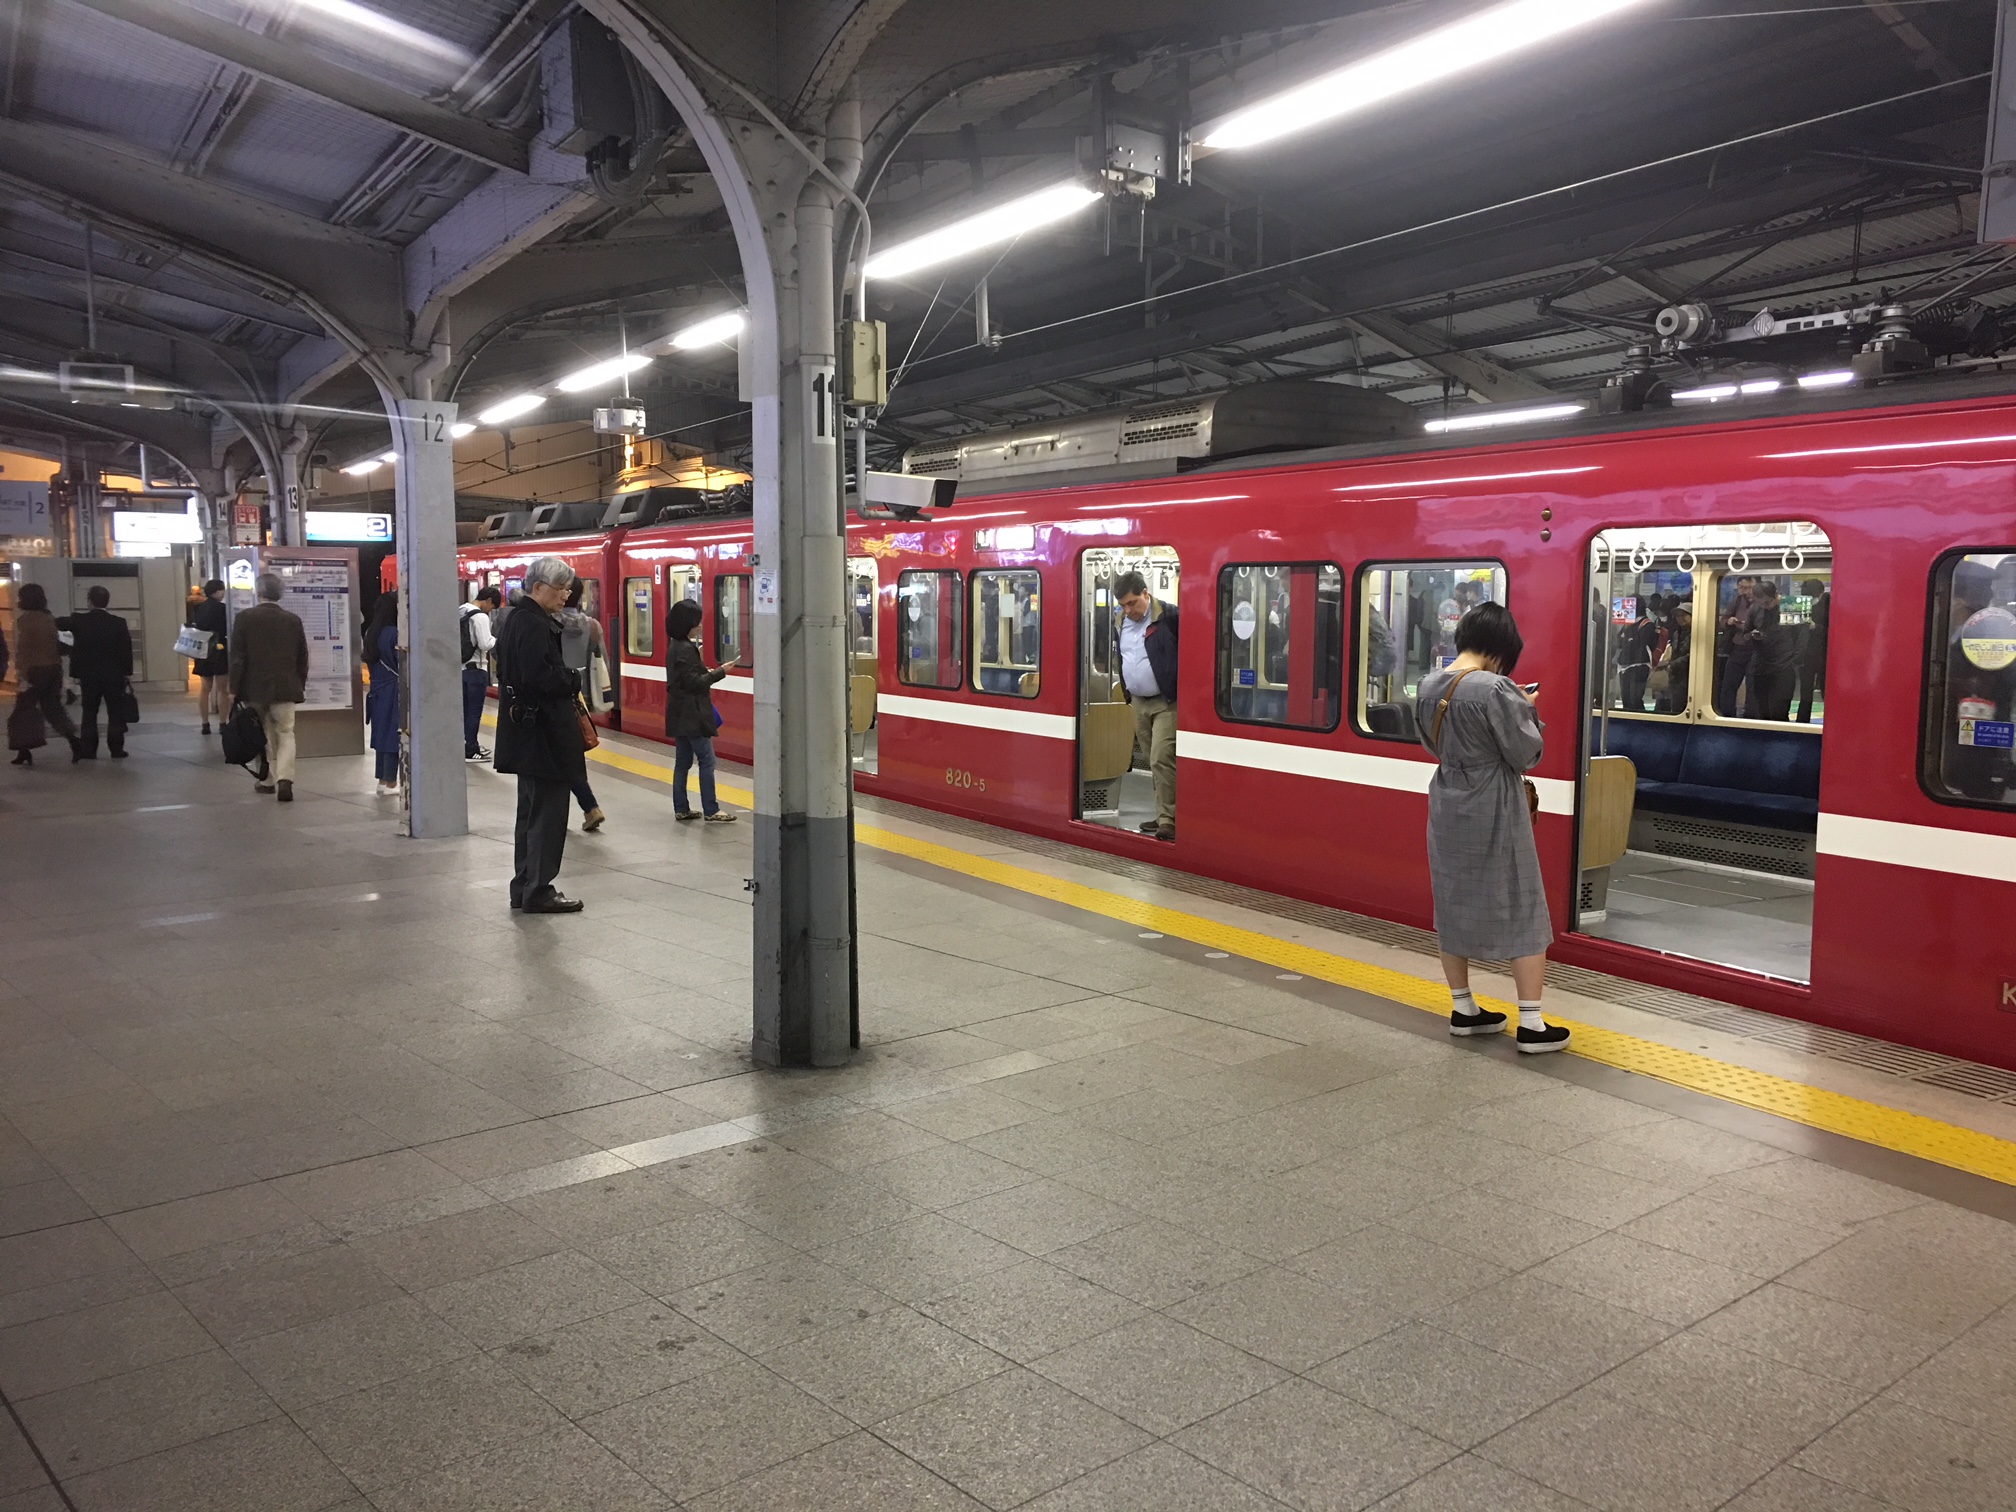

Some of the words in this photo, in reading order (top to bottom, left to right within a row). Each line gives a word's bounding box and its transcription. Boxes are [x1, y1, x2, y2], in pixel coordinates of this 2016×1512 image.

[813, 373, 835, 437] 11
[422, 412, 443, 442] 12
[35, 501, 44, 514] 2
[288, 486, 298, 510] 13
[367, 518, 387, 537] 2
[946, 767, 986, 792] 820-5
